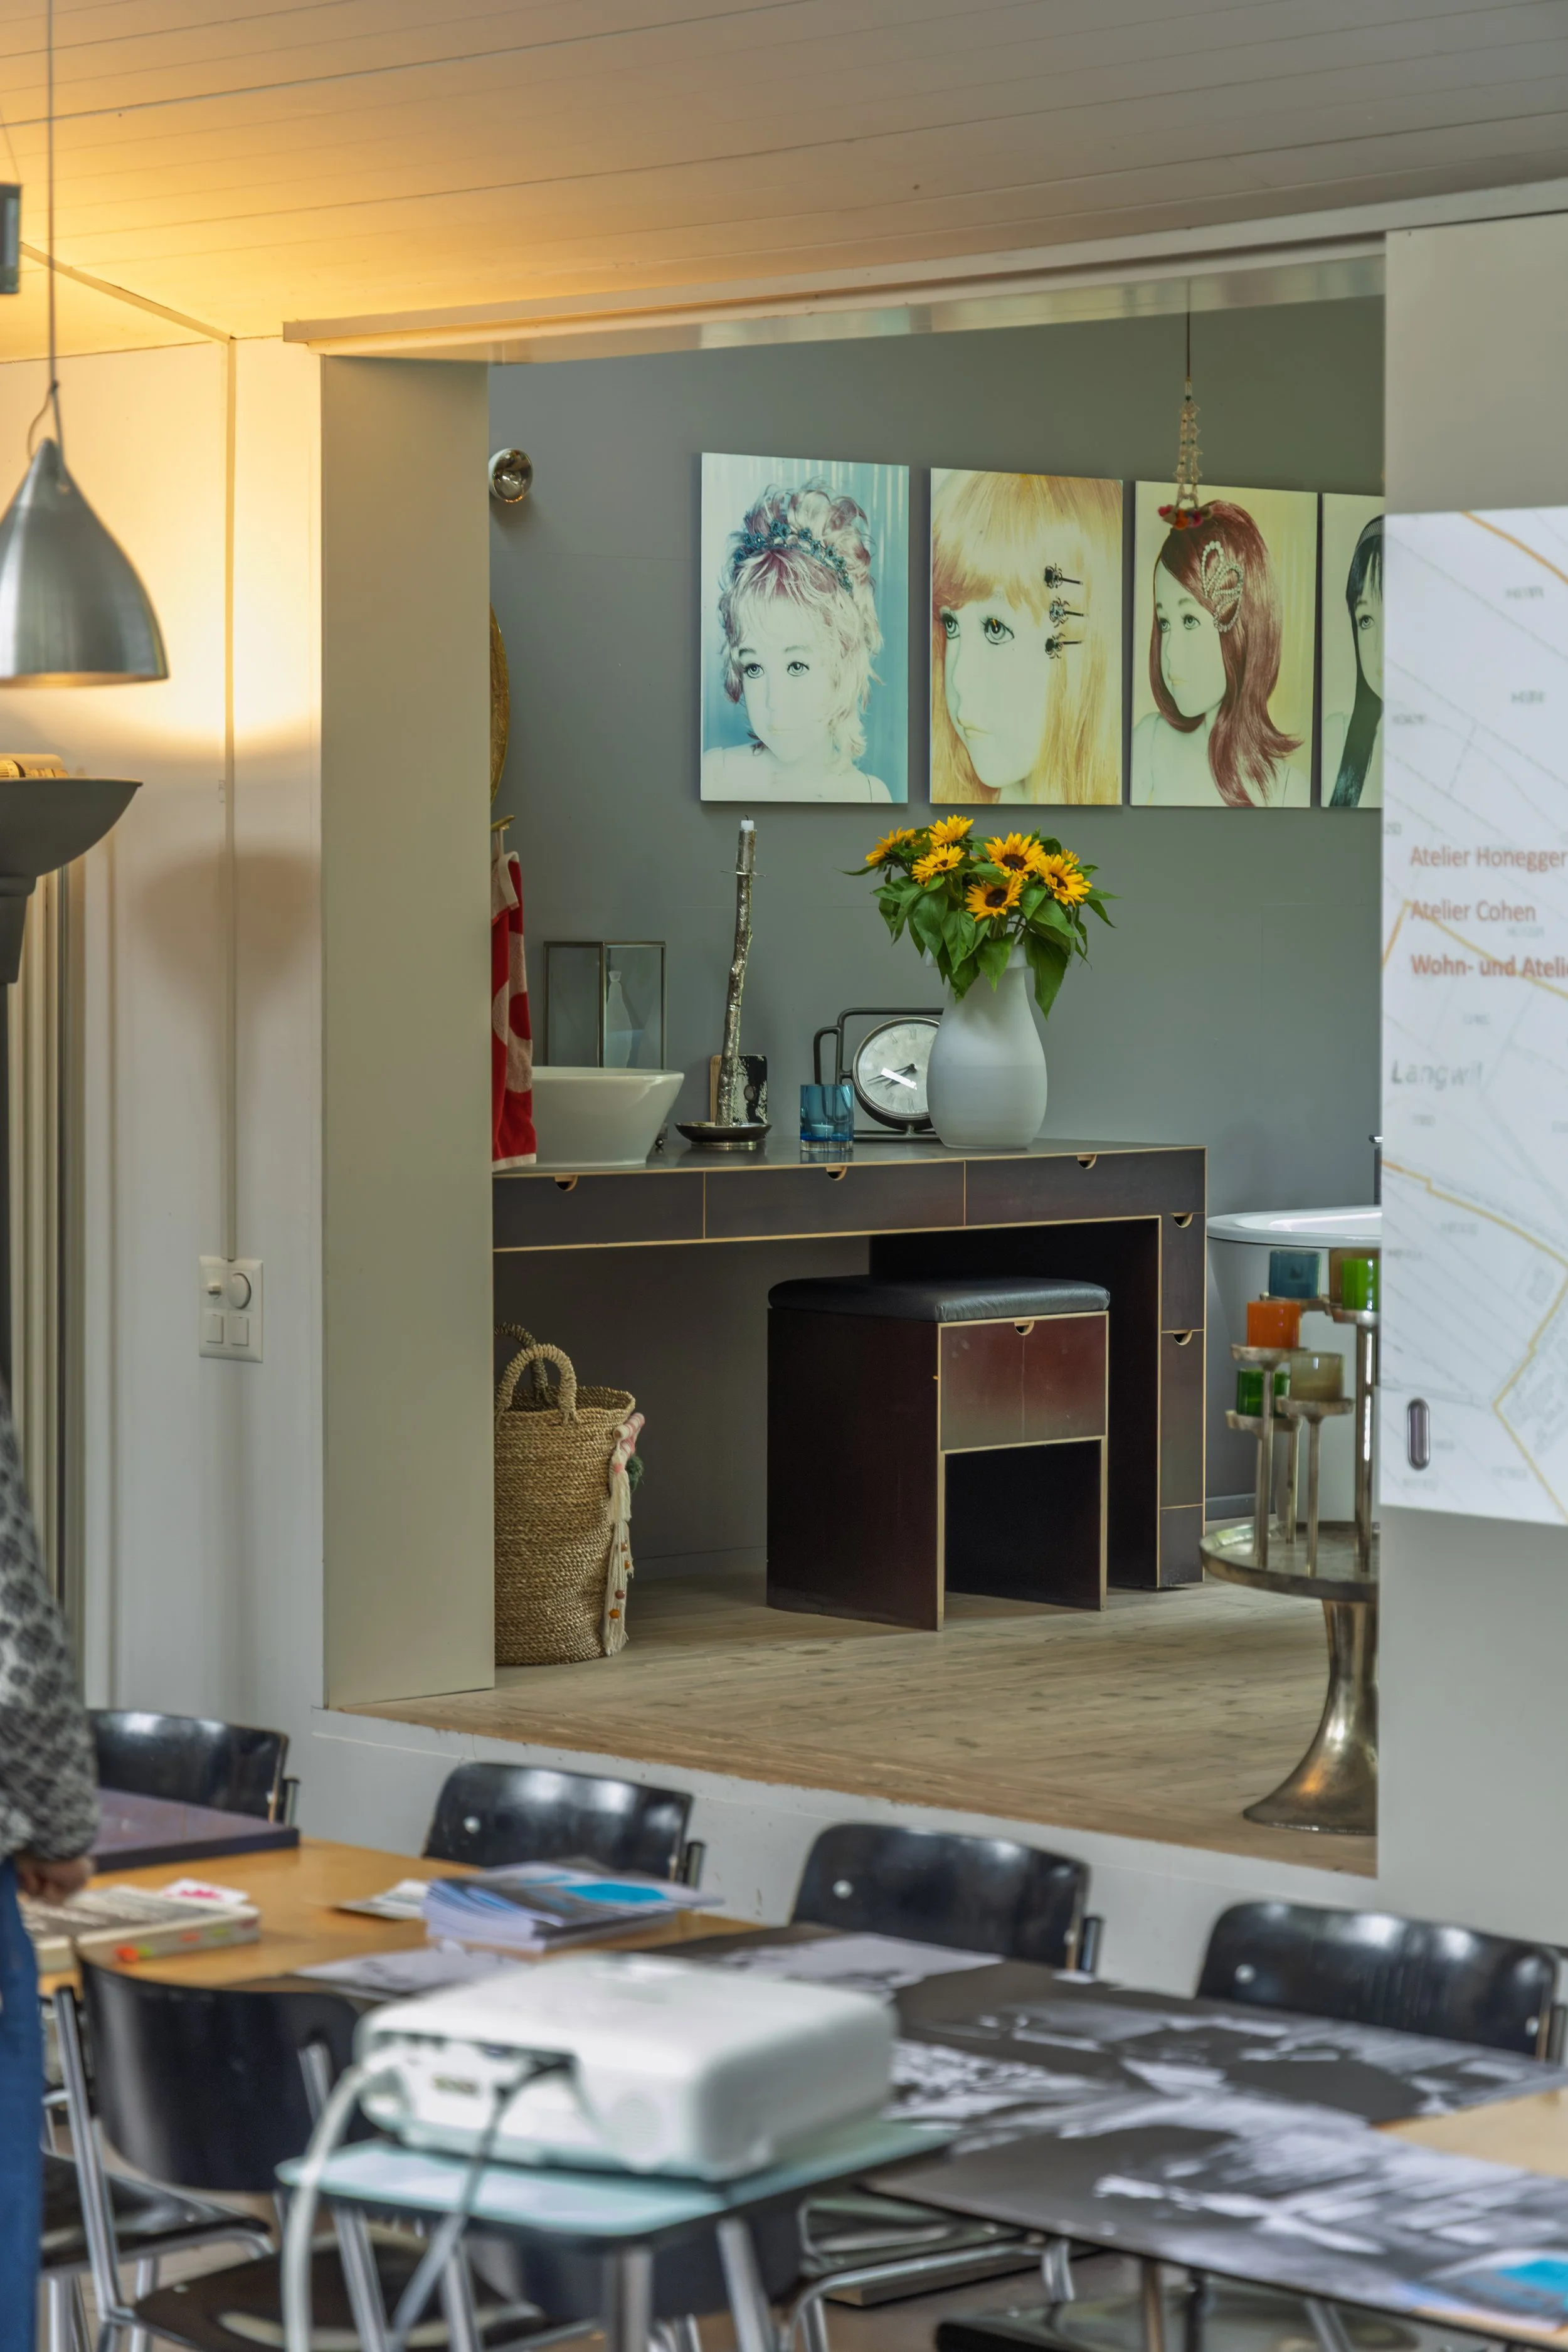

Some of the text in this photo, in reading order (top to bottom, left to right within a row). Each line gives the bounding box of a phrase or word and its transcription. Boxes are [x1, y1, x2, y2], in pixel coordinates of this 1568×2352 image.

[1410, 845, 1567, 872] Atelier Honegger
[1411, 899, 1536, 921] Atelier Cohen
[1411, 953, 1568, 978] Wohn- und Ateli
